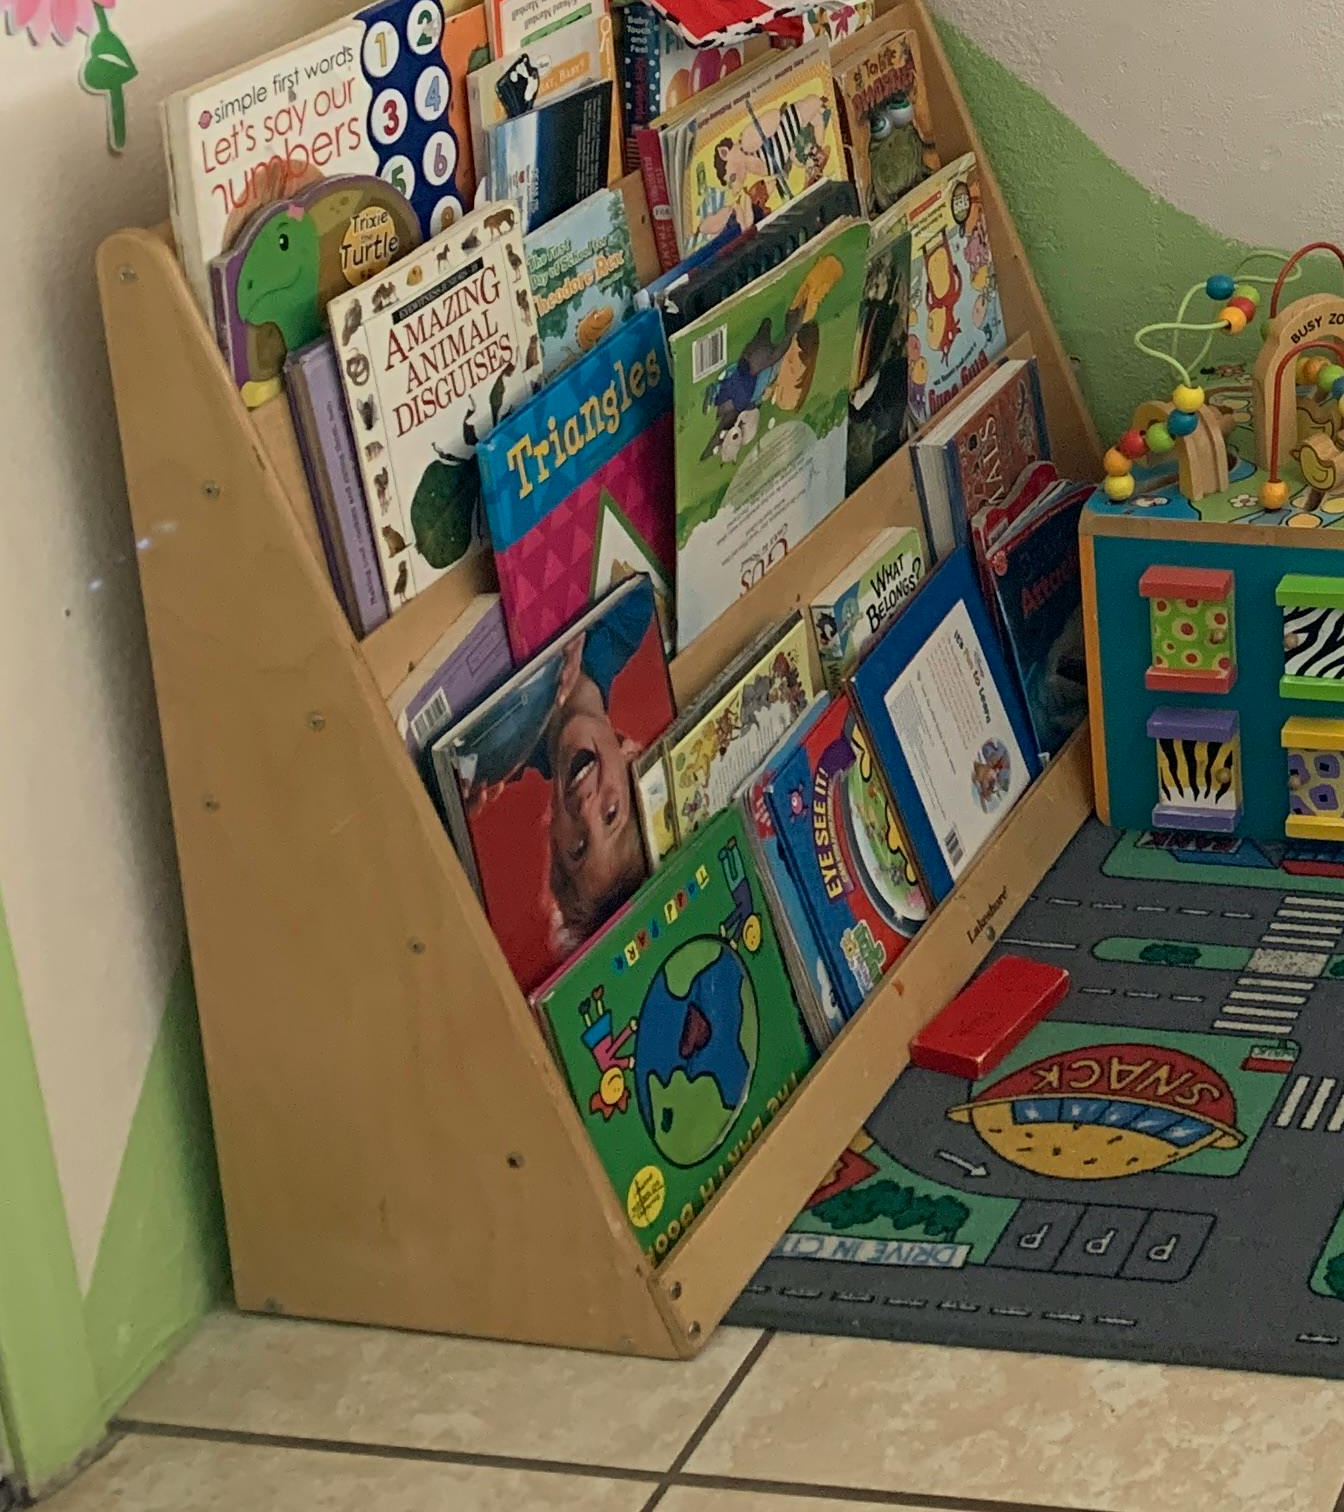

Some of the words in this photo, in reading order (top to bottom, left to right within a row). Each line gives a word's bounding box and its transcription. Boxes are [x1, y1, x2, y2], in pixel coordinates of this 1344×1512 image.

[374, 32, 389, 68] 1
[416, 9, 433, 47] 2
[214, 83, 268, 124] simple
[273, 68, 300, 100] first
[305, 43, 354, 81] words
[383, 110, 400, 136] 3
[425, 75, 442, 112] 4
[201, 122, 257, 174] Let's
[263, 95, 308, 142] say
[314, 76, 357, 116] our
[433, 142, 449, 177] 6
[352, 211, 389, 233] Trixie
[340, 236, 400, 270] Turtle
[383, 266, 501, 370] AMAZING
[1291, 315, 1324, 346] BUSY
[405, 311, 500, 393] ANIMAL
[393, 334, 515, 438] DISGUISES
[506, 346, 663, 500] Triangles
[866, 557, 921, 634] BELONGS?
[870, 554, 904, 600] WHAT
[814, 767, 829, 797] IT!
[813, 801, 830, 848] SEE
[818, 849, 843, 899] EYE
[966, 886, 1009, 946] Lakeshore
[612, 918, 660, 973] PARR
[1034, 1057, 1221, 1107] SNACK
[836, 1236, 868, 1260] IN
[871, 1238, 961, 1266] DRIVE
